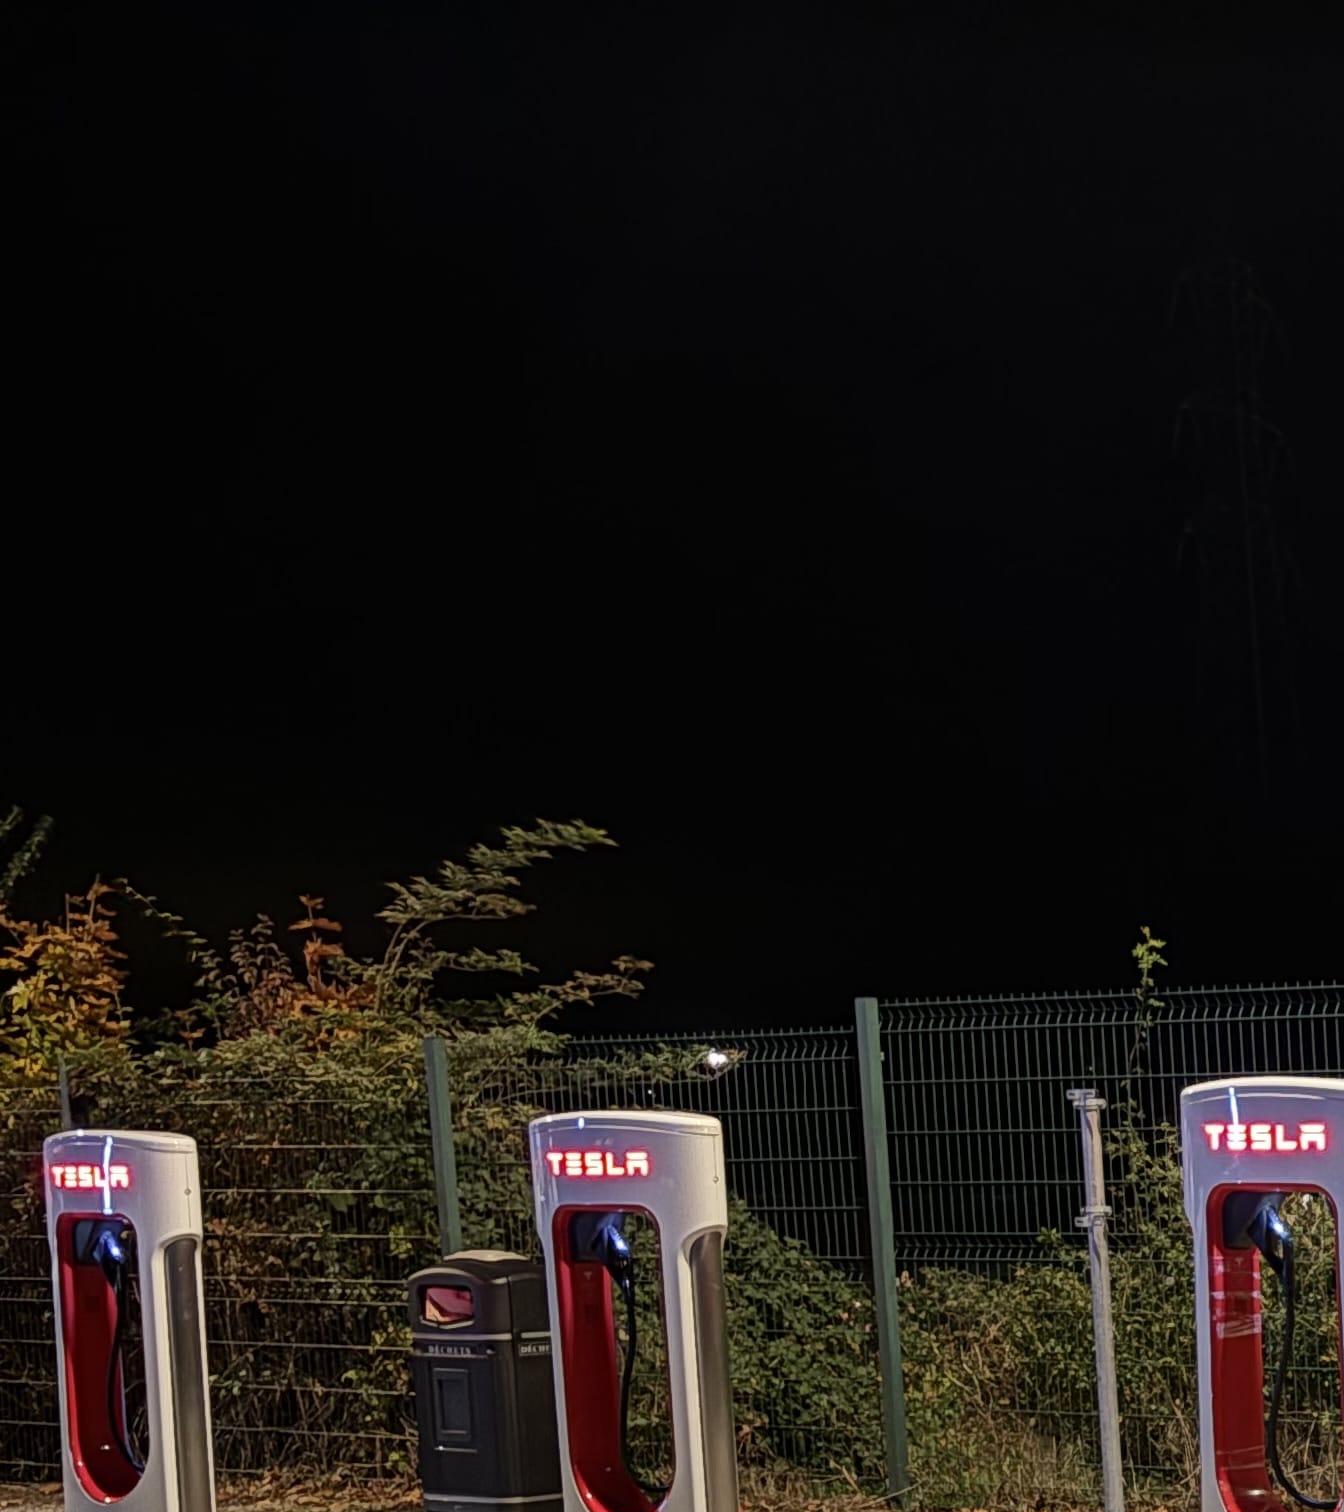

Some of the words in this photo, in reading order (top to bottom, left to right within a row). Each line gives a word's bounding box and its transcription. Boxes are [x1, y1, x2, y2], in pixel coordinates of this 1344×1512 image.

[1204, 1123, 1326, 1151] TESLA
[546, 1151, 649, 1176] TESLA
[51, 1165, 129, 1188] TESLA
